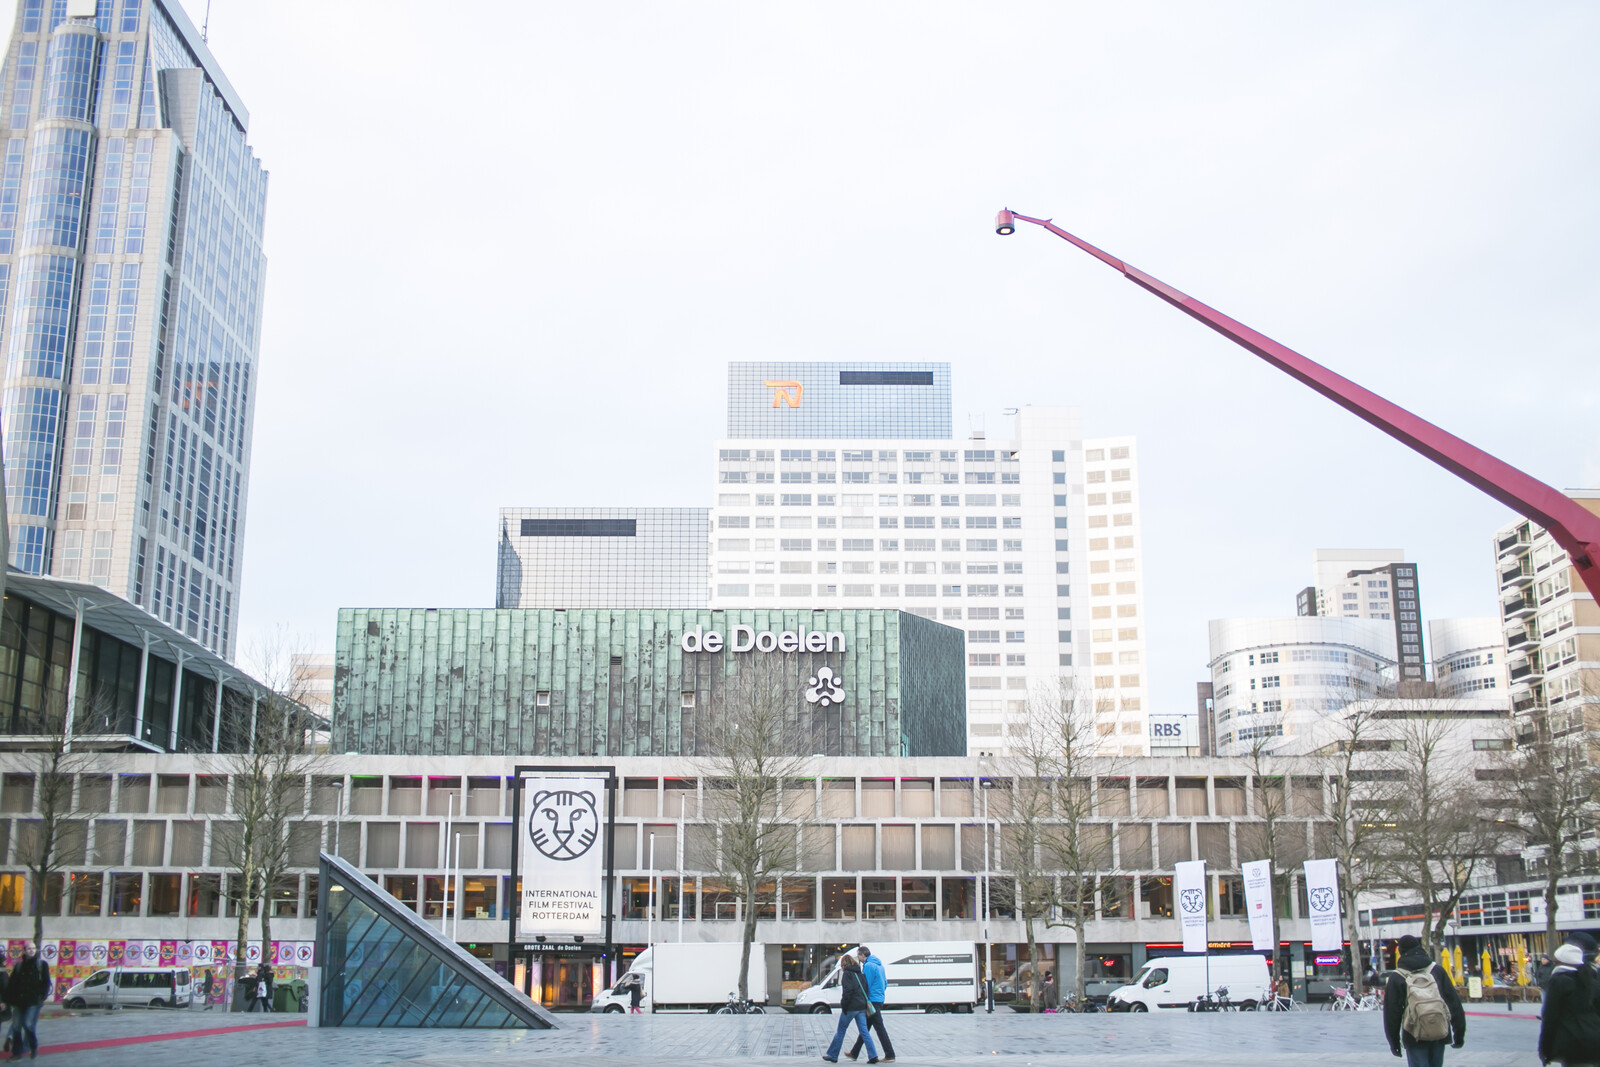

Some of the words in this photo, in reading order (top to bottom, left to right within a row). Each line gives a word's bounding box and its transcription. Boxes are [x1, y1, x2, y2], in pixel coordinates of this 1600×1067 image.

[681, 624, 724, 653] de
[731, 624, 846, 653] Doelen
[1154, 723, 1182, 736] RBS
[525, 890, 598, 898] INTERNATIONAL
